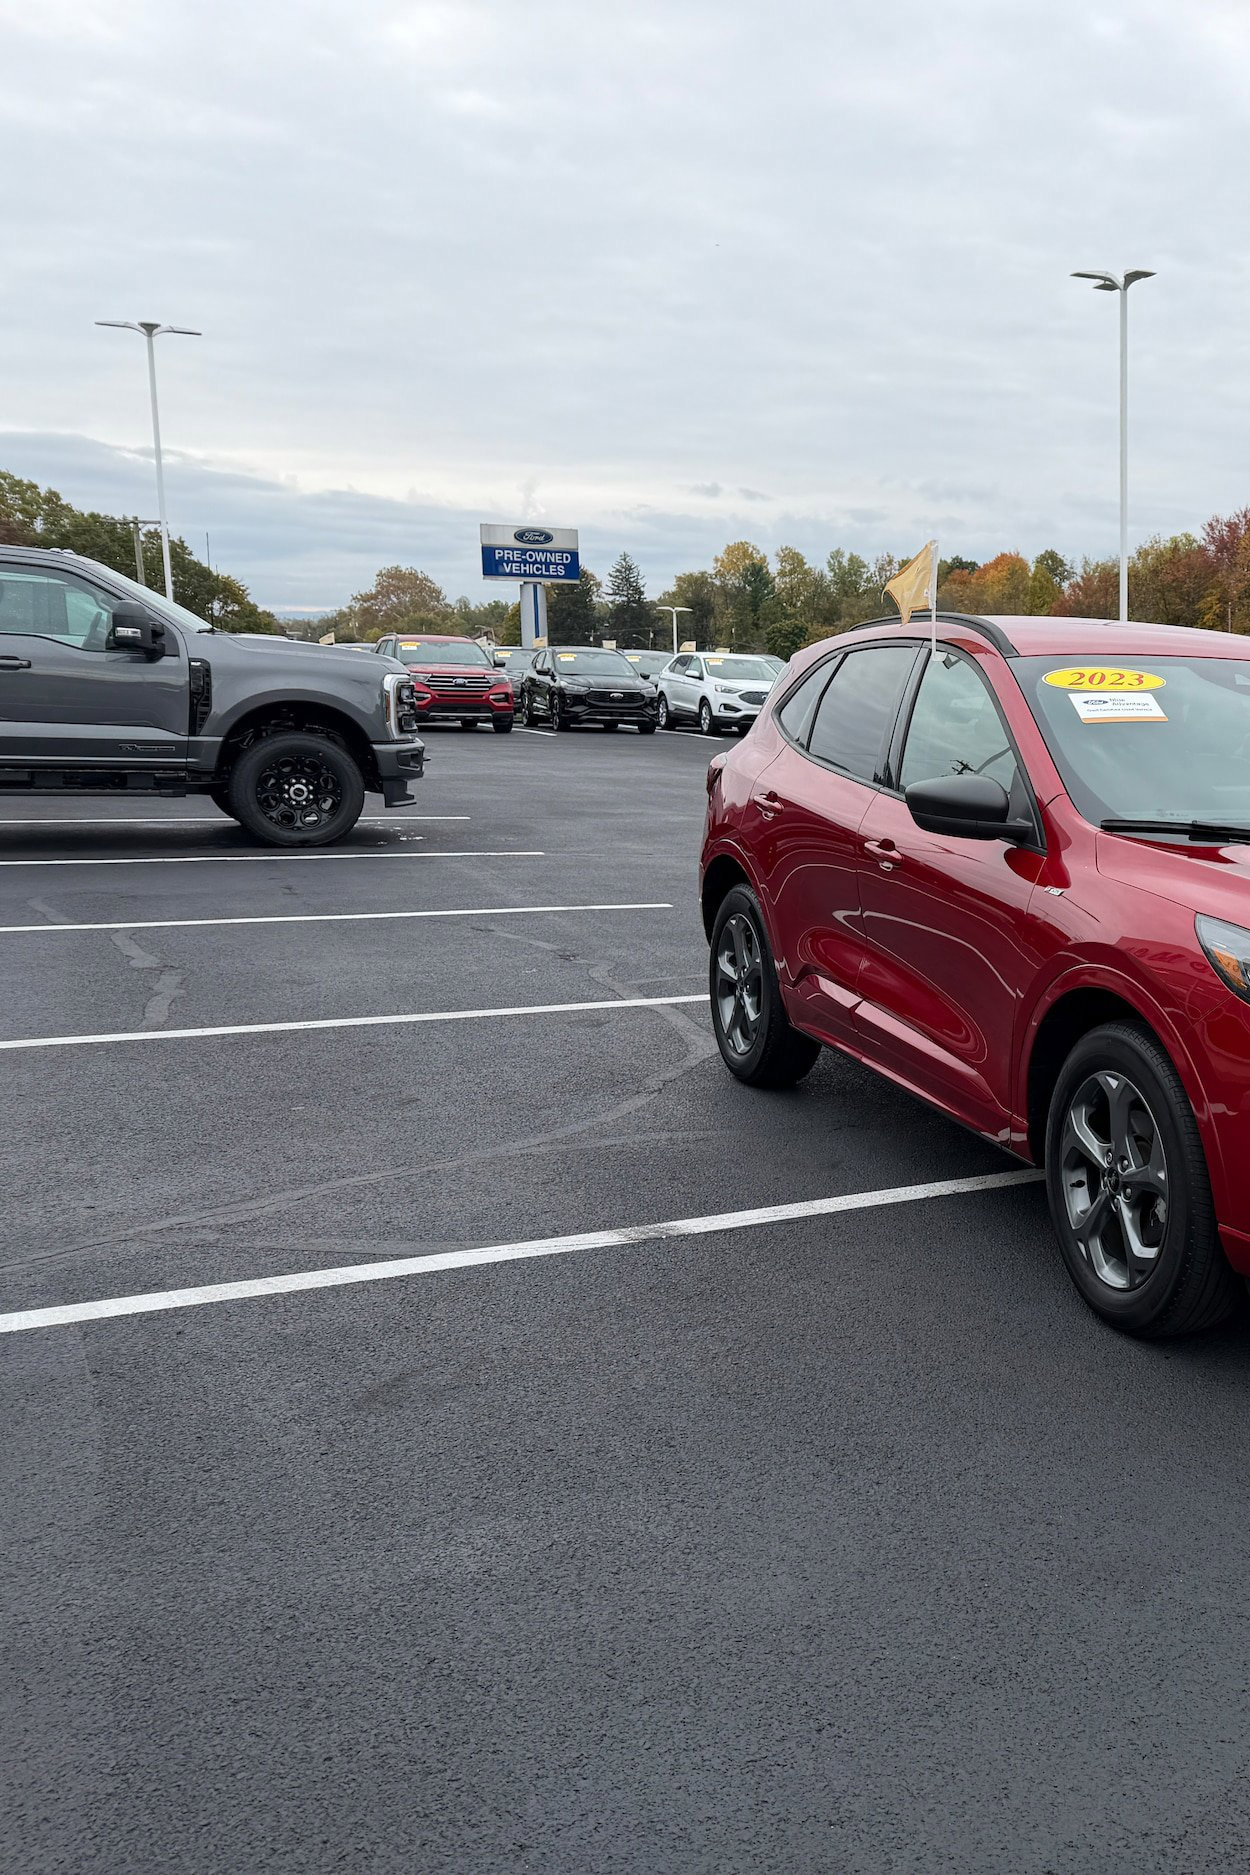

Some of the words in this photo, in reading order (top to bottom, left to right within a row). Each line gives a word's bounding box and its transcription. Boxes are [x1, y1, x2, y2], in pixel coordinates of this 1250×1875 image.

[522, 532, 545, 541] Ford
[494, 549, 572, 563] PRE-OWNED
[502, 562, 566, 576] VEHICLES
[1068, 672, 1144, 686] 2023
